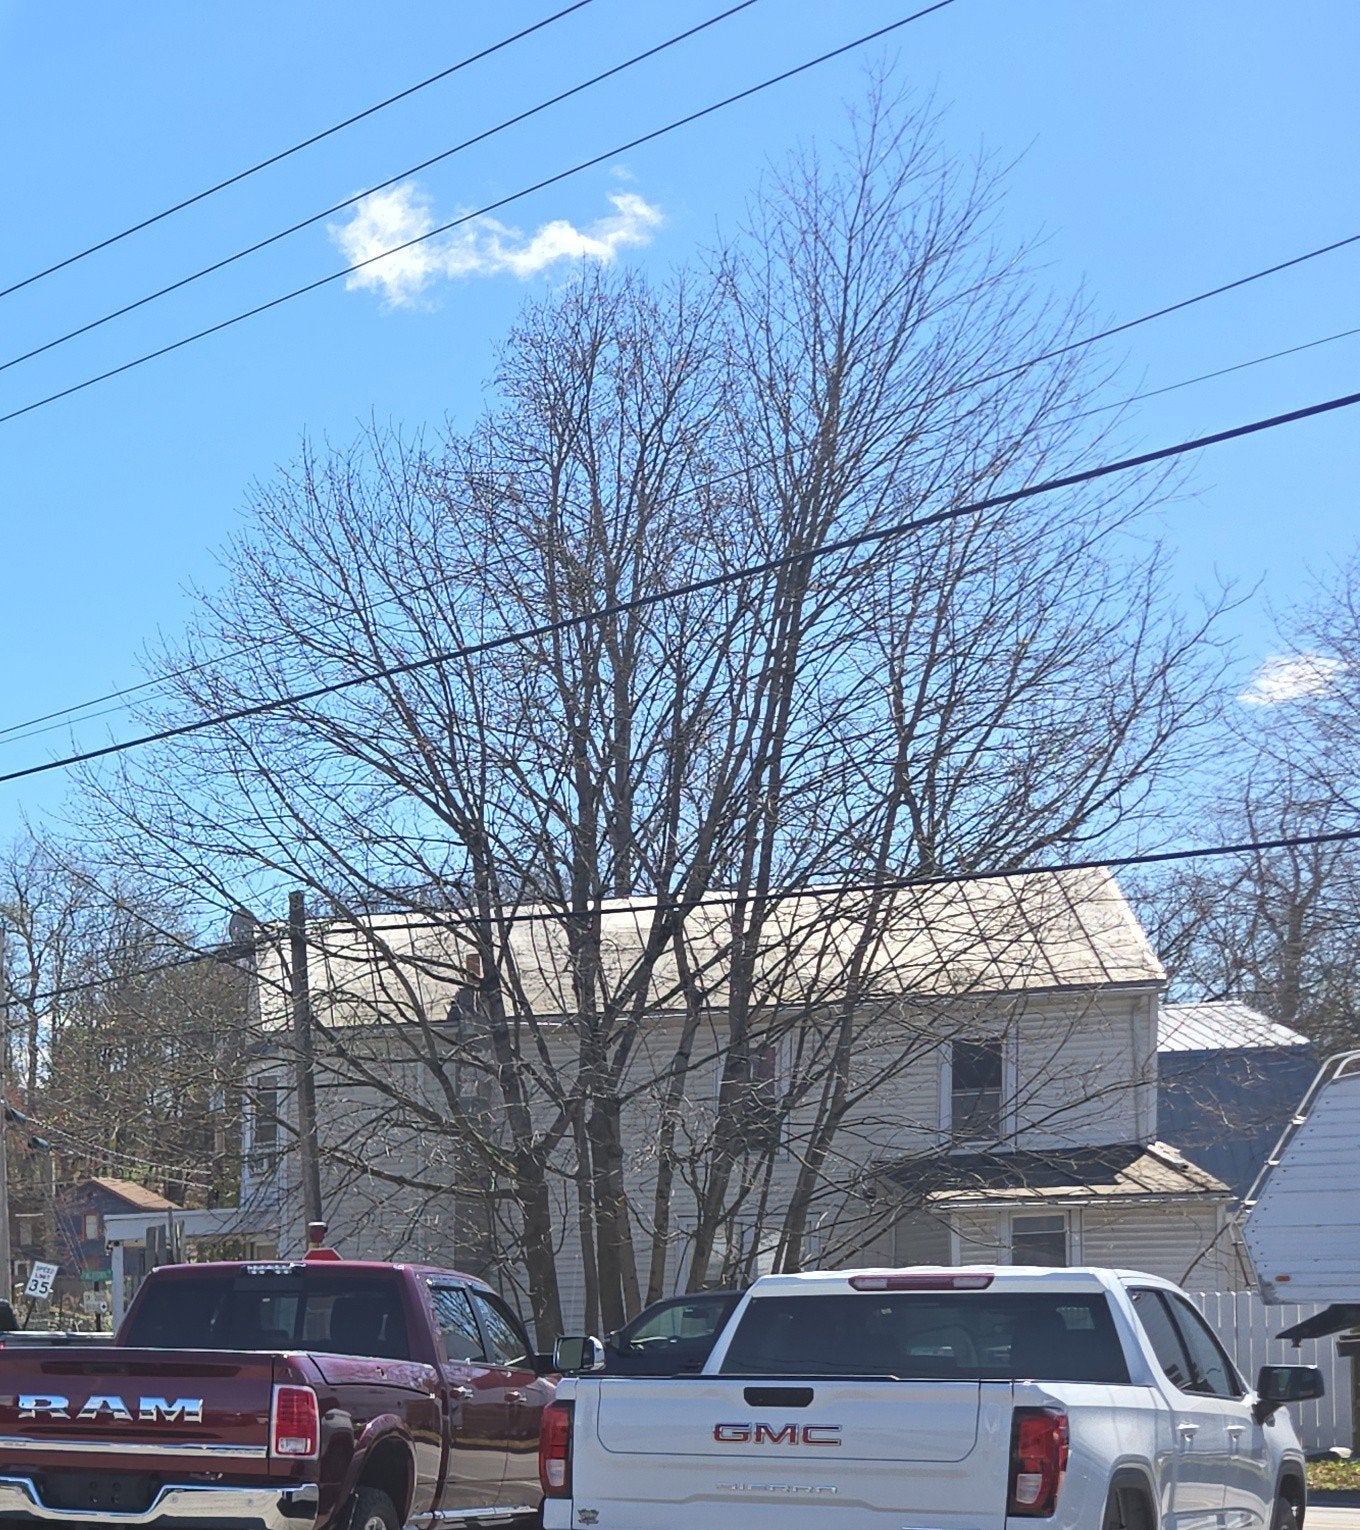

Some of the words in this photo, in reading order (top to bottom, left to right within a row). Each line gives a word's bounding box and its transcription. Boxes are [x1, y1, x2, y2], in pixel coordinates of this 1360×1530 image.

[36, 1265, 54, 1275] SPEED
[28, 1279, 49, 1294] 35
[18, 1394, 205, 1423] RAM
[713, 1422, 843, 1446] GMC
